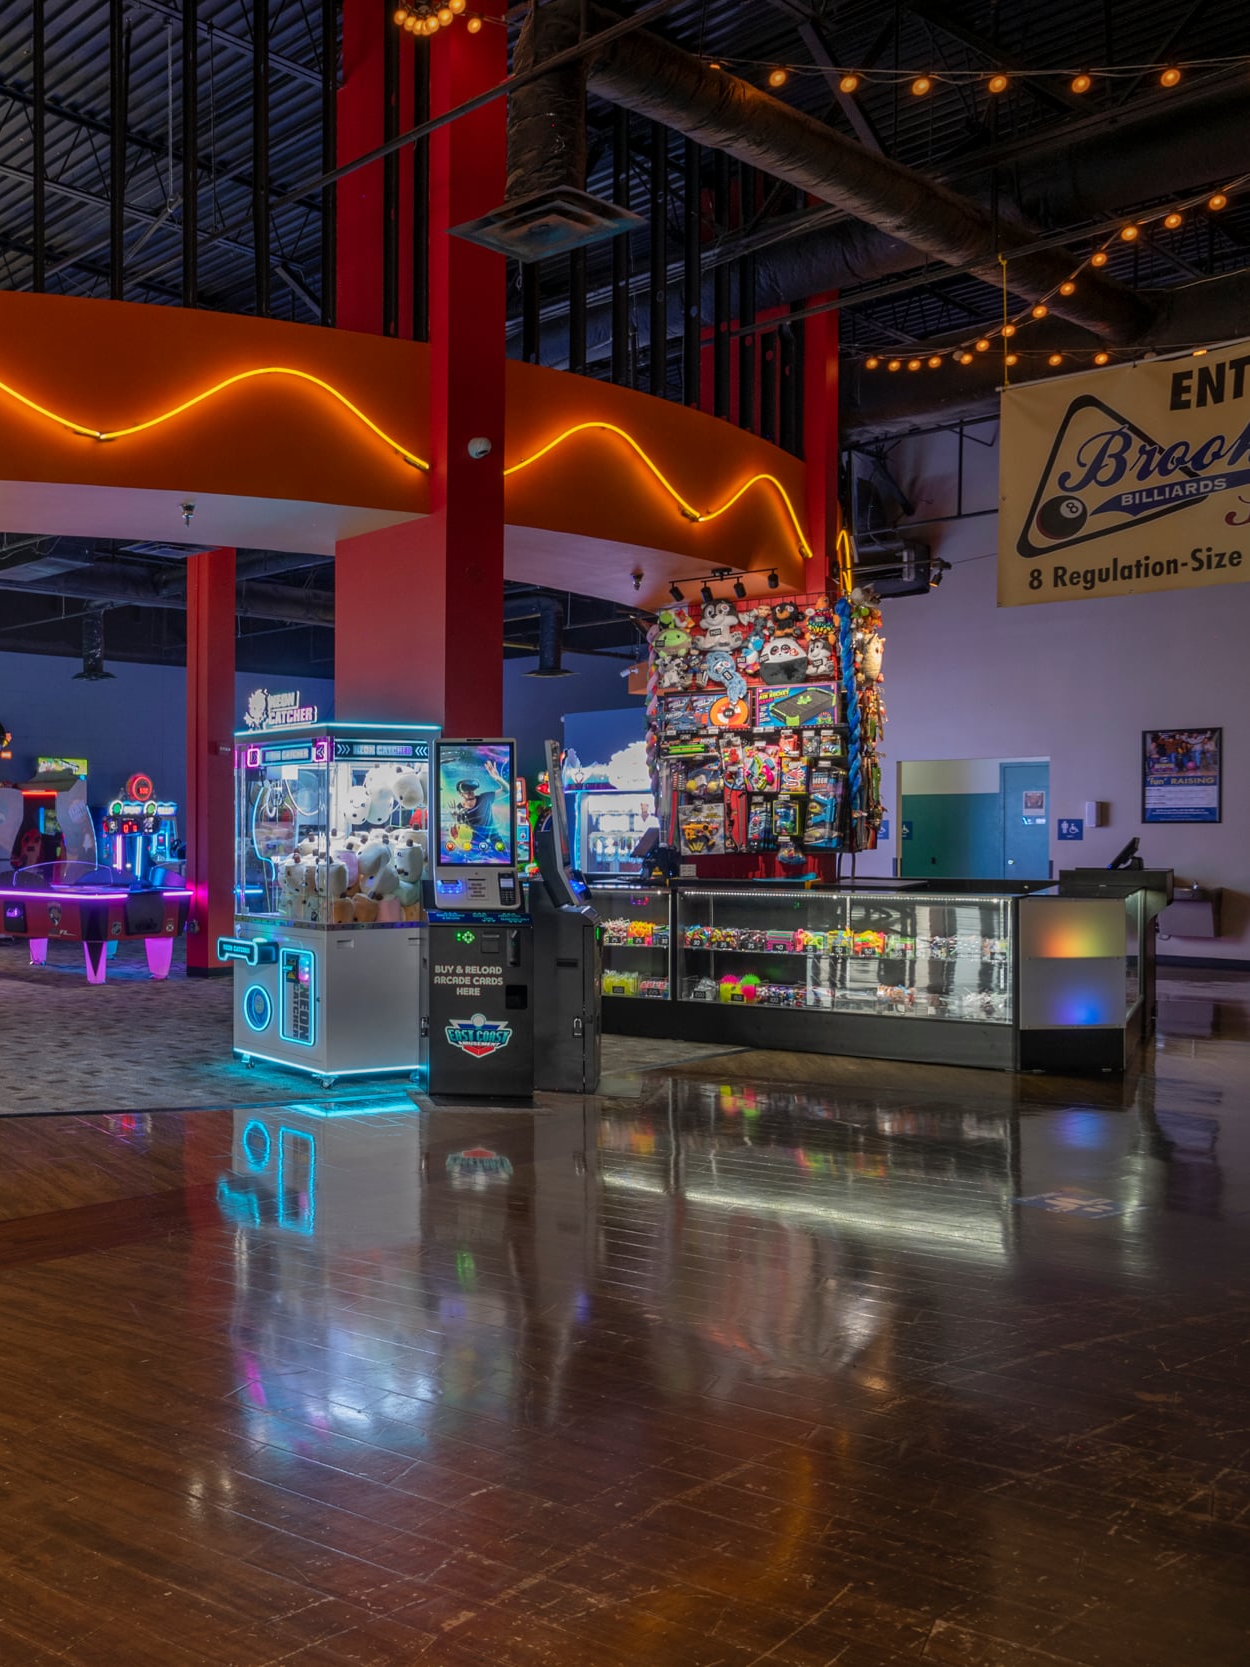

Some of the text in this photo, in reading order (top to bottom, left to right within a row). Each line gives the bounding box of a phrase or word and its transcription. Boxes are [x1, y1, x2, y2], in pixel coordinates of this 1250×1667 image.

[1120, 478, 1227, 506] BILLIARDS
[1028, 547, 1242, 591] 8 Regulation-Size
[268, 706, 313, 725] CATCHER
[1170, 777, 1215, 785] RAISING
[434, 965, 503, 975] BUY & RELOAD
[433, 976, 503, 986] ARCADE CARDS
[456, 987, 481, 996] HERE
[448, 1029, 510, 1043] EAST COAST
